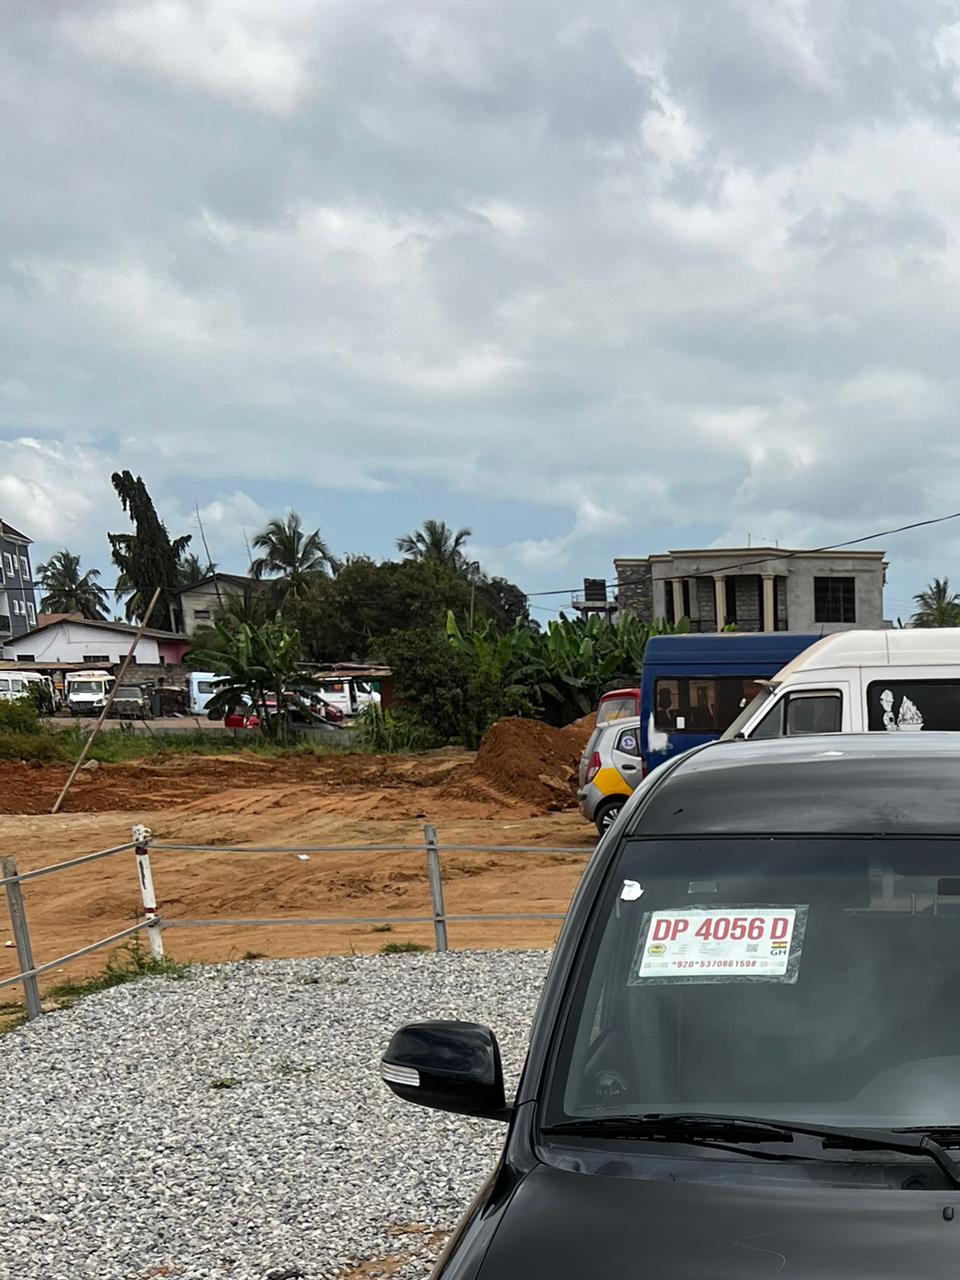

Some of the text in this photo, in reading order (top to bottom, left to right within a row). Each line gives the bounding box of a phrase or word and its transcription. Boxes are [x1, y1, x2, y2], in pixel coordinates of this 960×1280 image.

[652, 917, 789, 941] DP 4056 D
